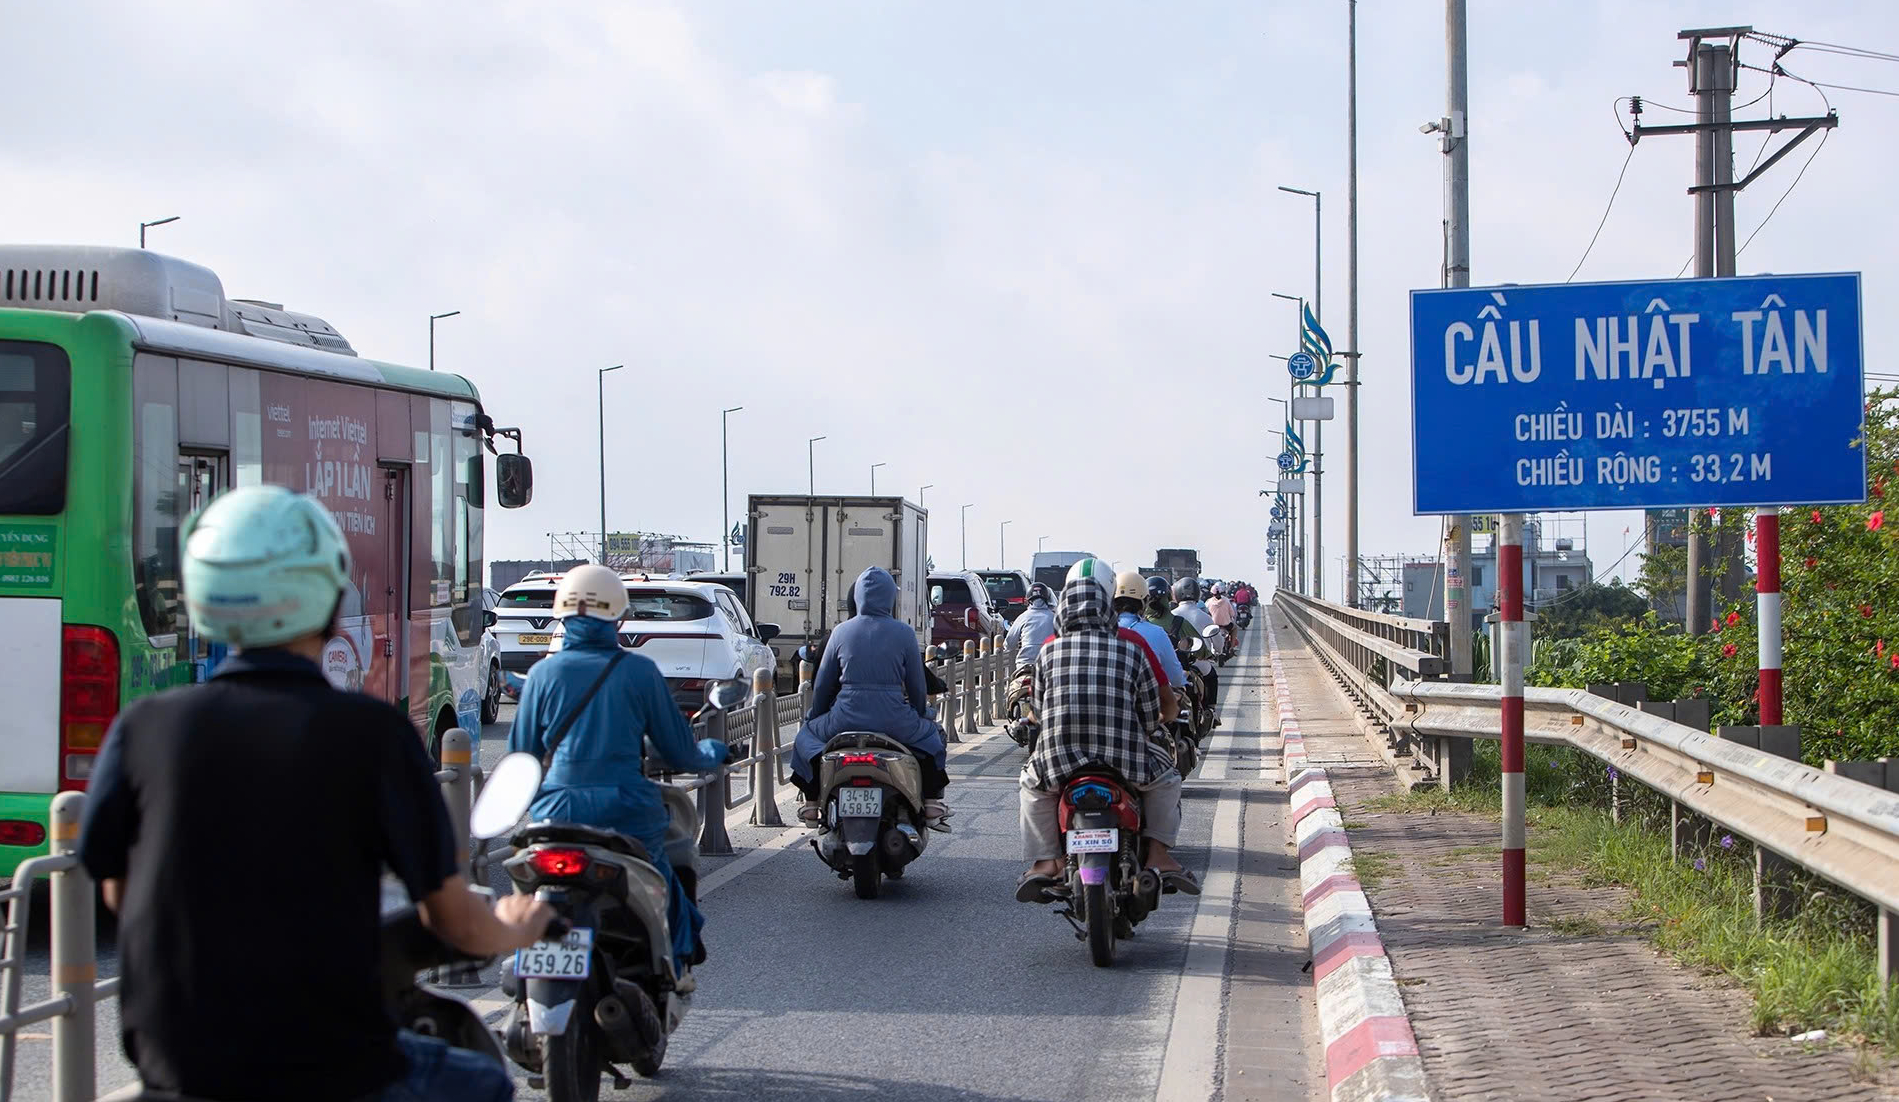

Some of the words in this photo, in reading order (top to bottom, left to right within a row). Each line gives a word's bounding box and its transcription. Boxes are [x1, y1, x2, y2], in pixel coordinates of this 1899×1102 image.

[1444, 292, 1541, 385] CẦU
[1575, 298, 1700, 389] NHẬT
[1731, 294, 1828, 375] TÂN
[309, 415, 340, 440] Internet
[341, 416, 367, 445] Viettel
[1515, 400, 1583, 441] CHIỀU
[1596, 402, 1634, 439] DÀI
[1662, 409, 1721, 437] 3755
[1728, 407, 1749, 436] M
[306, 439, 334, 497] LẮP
[1516, 448, 1584, 486] CHIỀU
[1597, 451, 1661, 491] RỘNG
[1690, 453, 1744, 485] 33,2
[1750, 453, 1772, 481] M
[770, 585, 801, 597] 792.82
[778, 572, 796, 584] 29H
[846, 789, 876, 802] 34-B4
[841, 802, 880, 816] 458.52
[521, 953, 585, 976] 459.26
